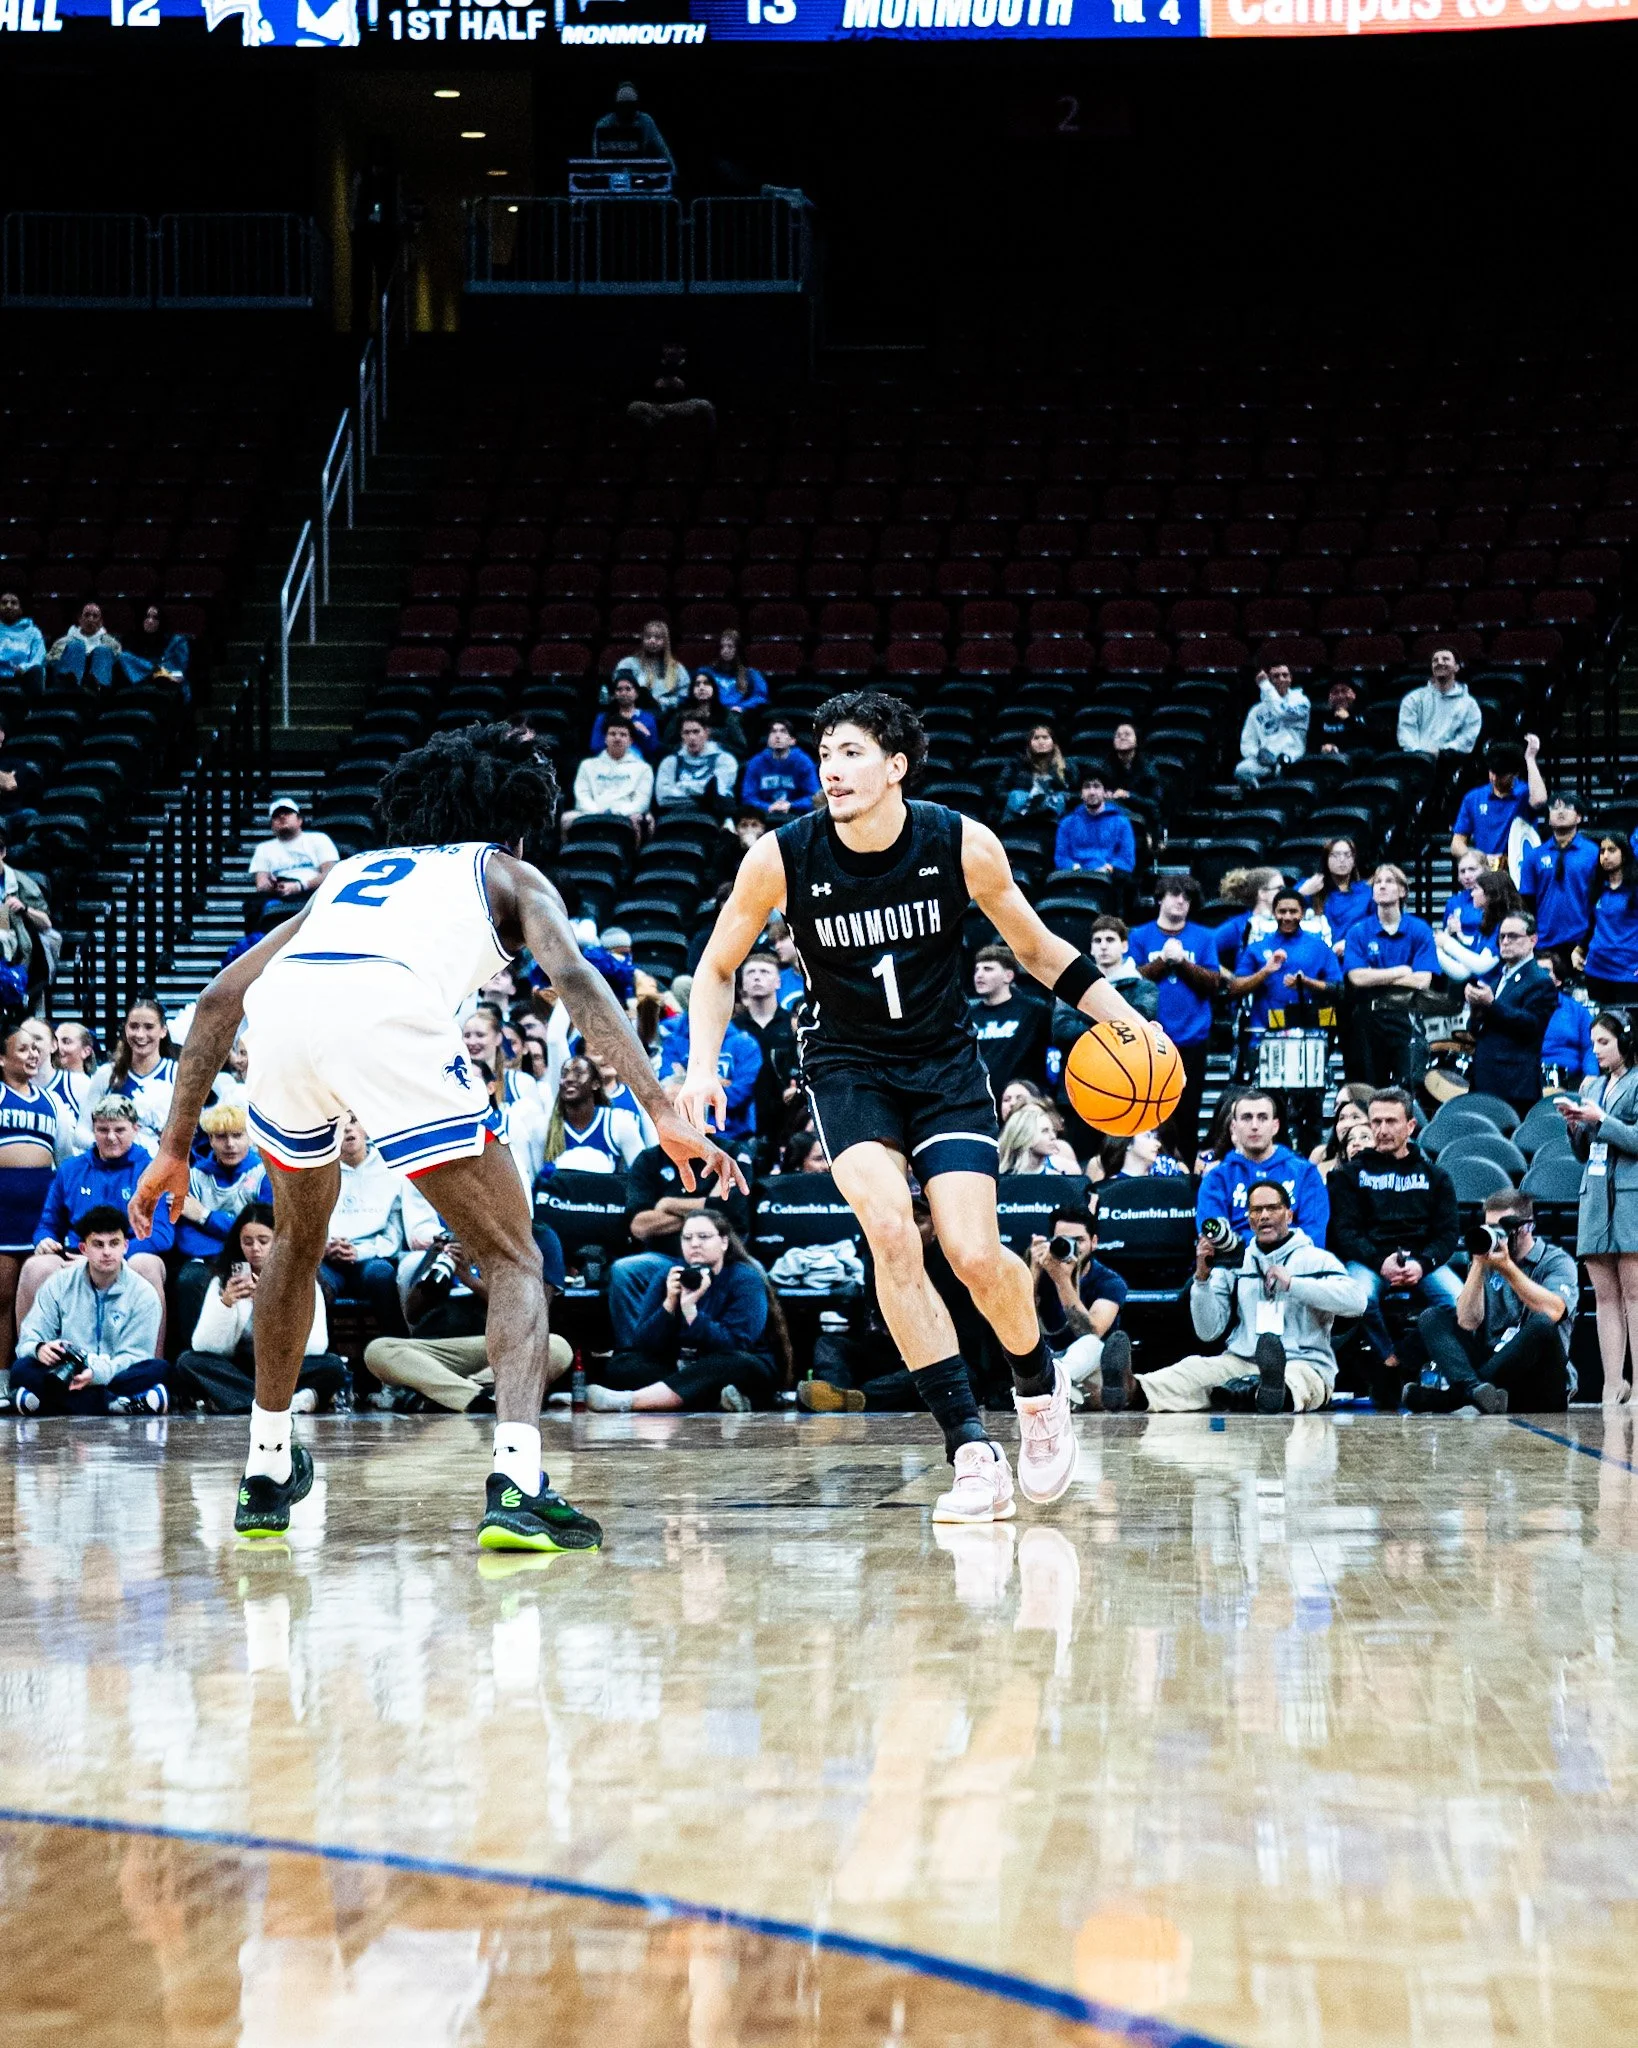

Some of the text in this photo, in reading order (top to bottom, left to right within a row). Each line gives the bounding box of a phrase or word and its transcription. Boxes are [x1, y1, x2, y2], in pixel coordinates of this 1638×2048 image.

[388, 10, 547, 41] 1ST HALF
[561, 24, 707, 45] MONMOUTH
[1056, 95, 1079, 131] 2
[331, 857, 417, 907] 2
[918, 866, 940, 877] CAA
[814, 899, 942, 948] MONMOUTH
[871, 953, 903, 1020] 1
[1107, 1019, 1137, 1045] CAA
[549, 1197, 606, 1213] Columbia
[770, 1203, 829, 1214] Columbia
[996, 1203, 1054, 1214] Columbia
[1111, 1208, 1169, 1220] Columbia
